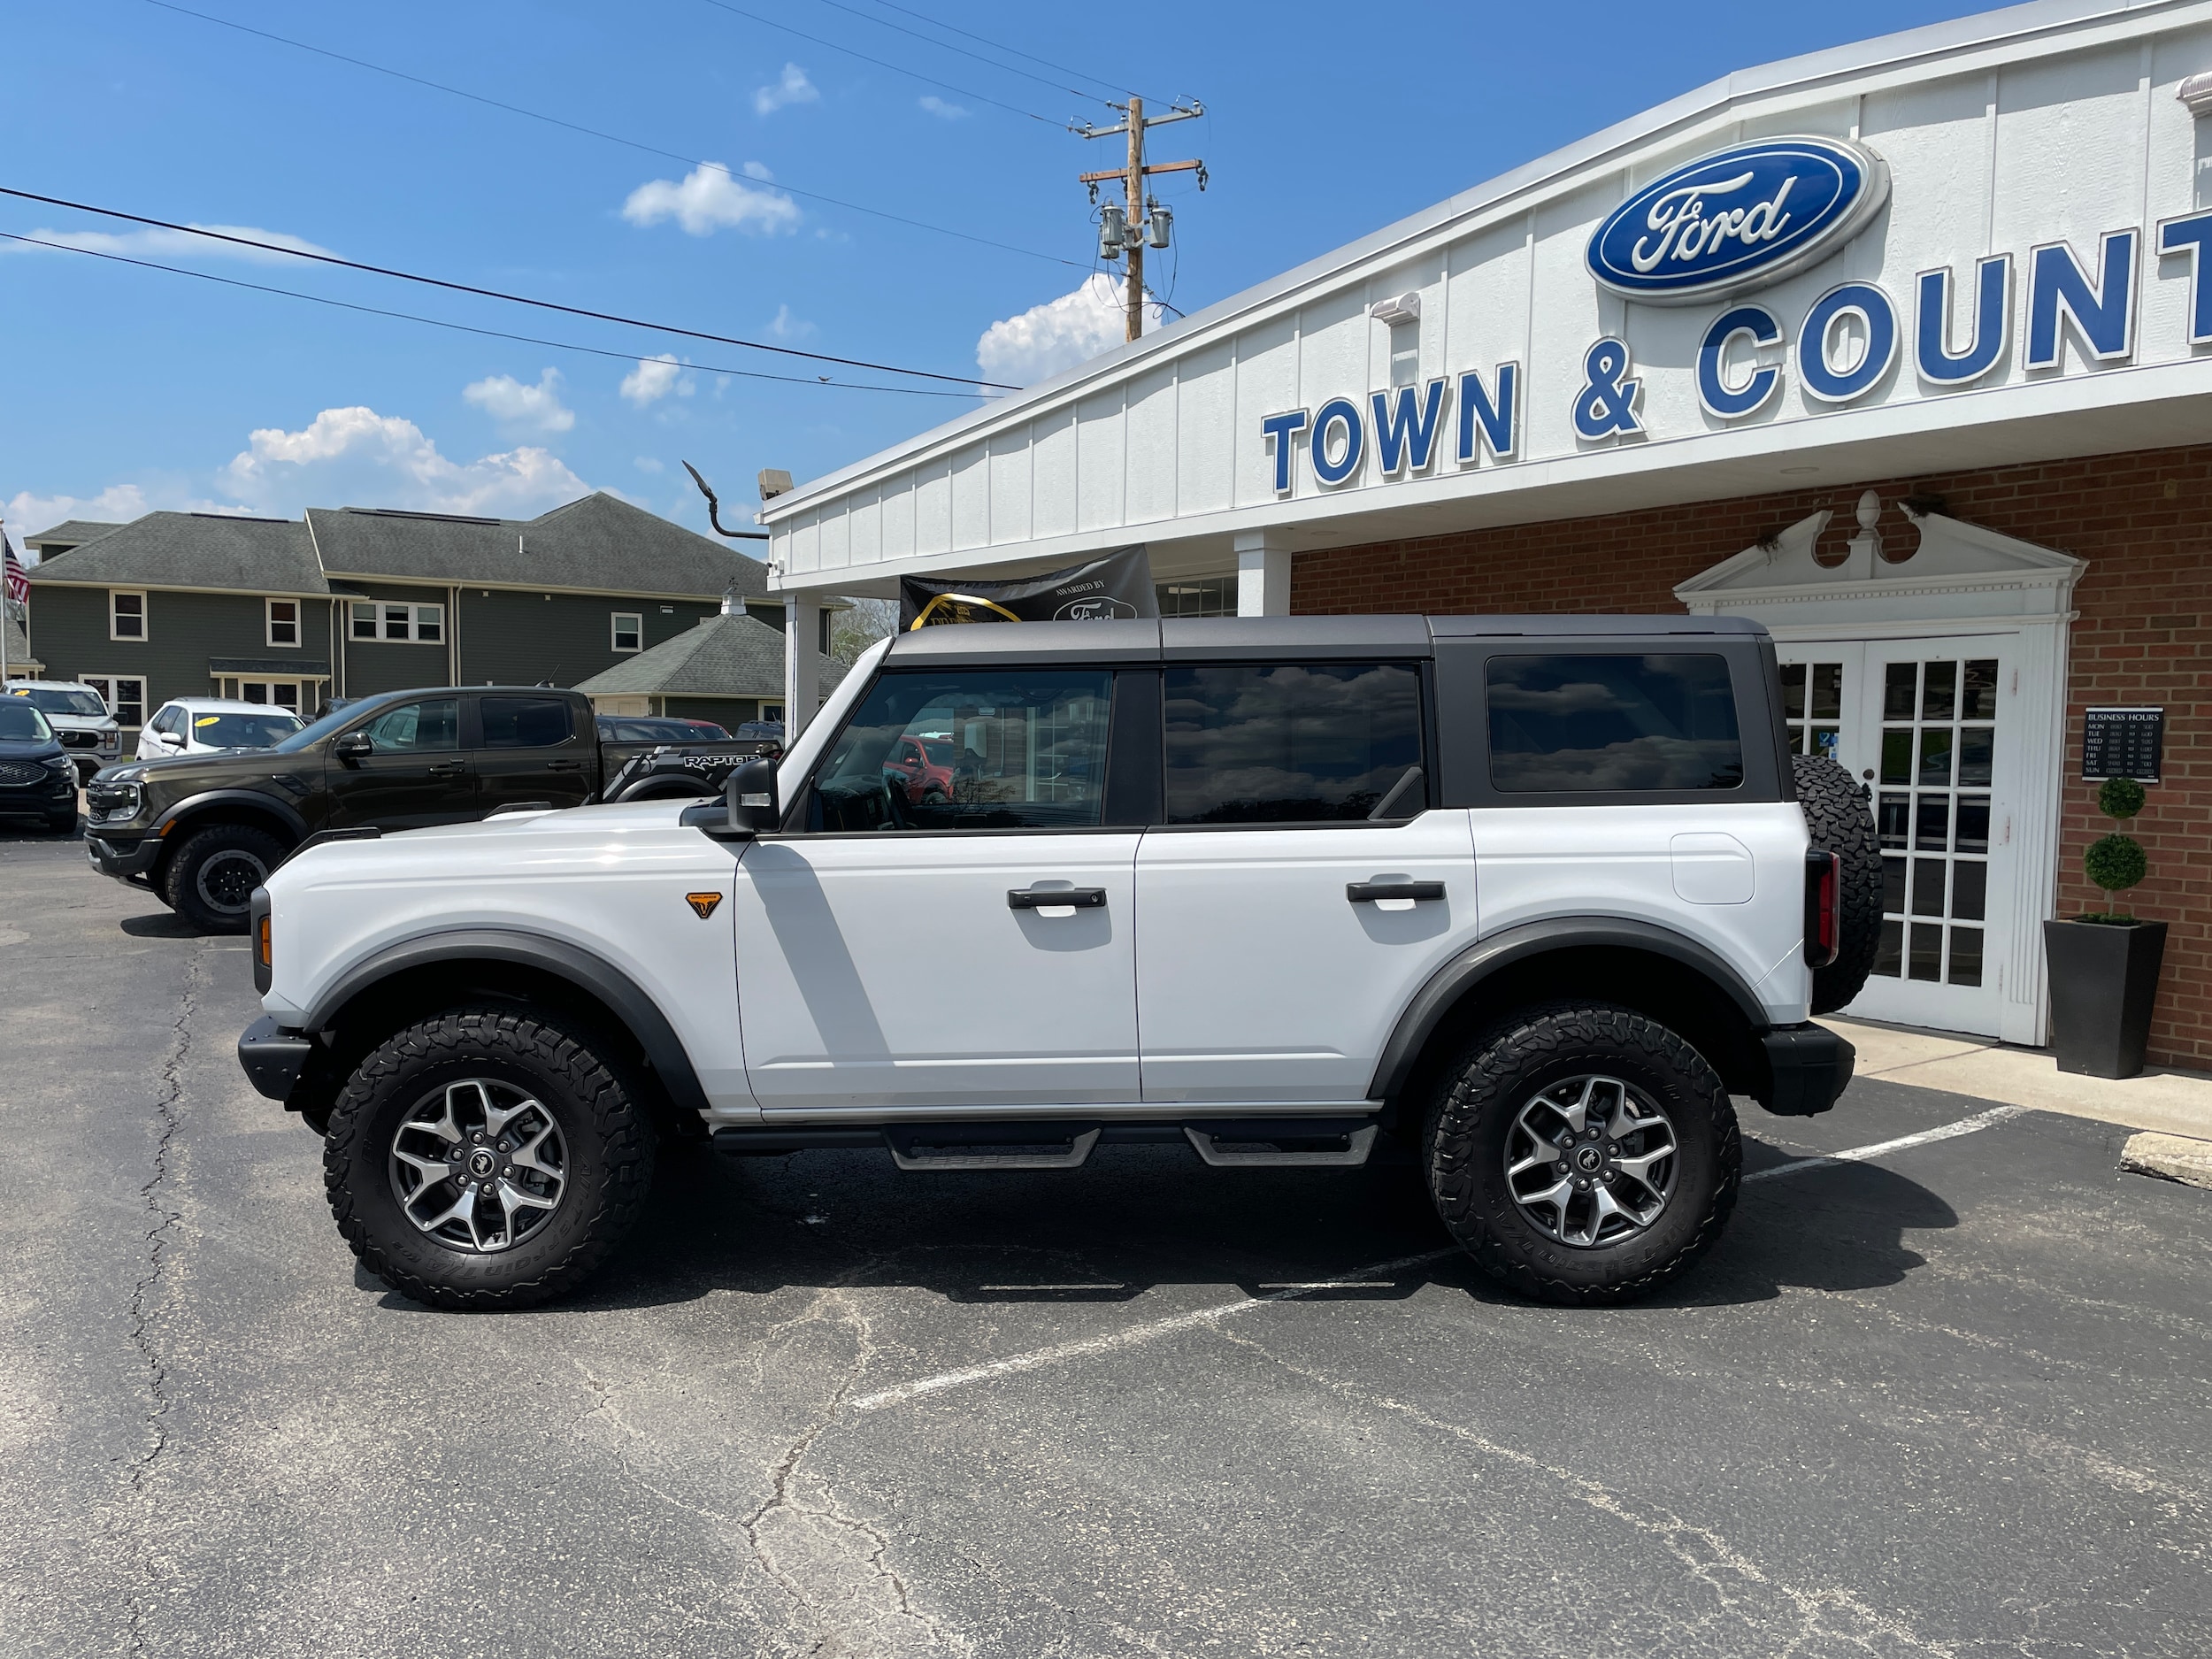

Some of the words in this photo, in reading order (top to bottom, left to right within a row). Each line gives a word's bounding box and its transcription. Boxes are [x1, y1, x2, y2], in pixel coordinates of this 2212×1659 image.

[1631, 171, 1798, 273] Ford
[1261, 360, 1520, 494] TOWN
[1571, 335, 1647, 442] &
[1056, 582, 1094, 596] AWARDED
[1093, 580, 1105, 590] BY
